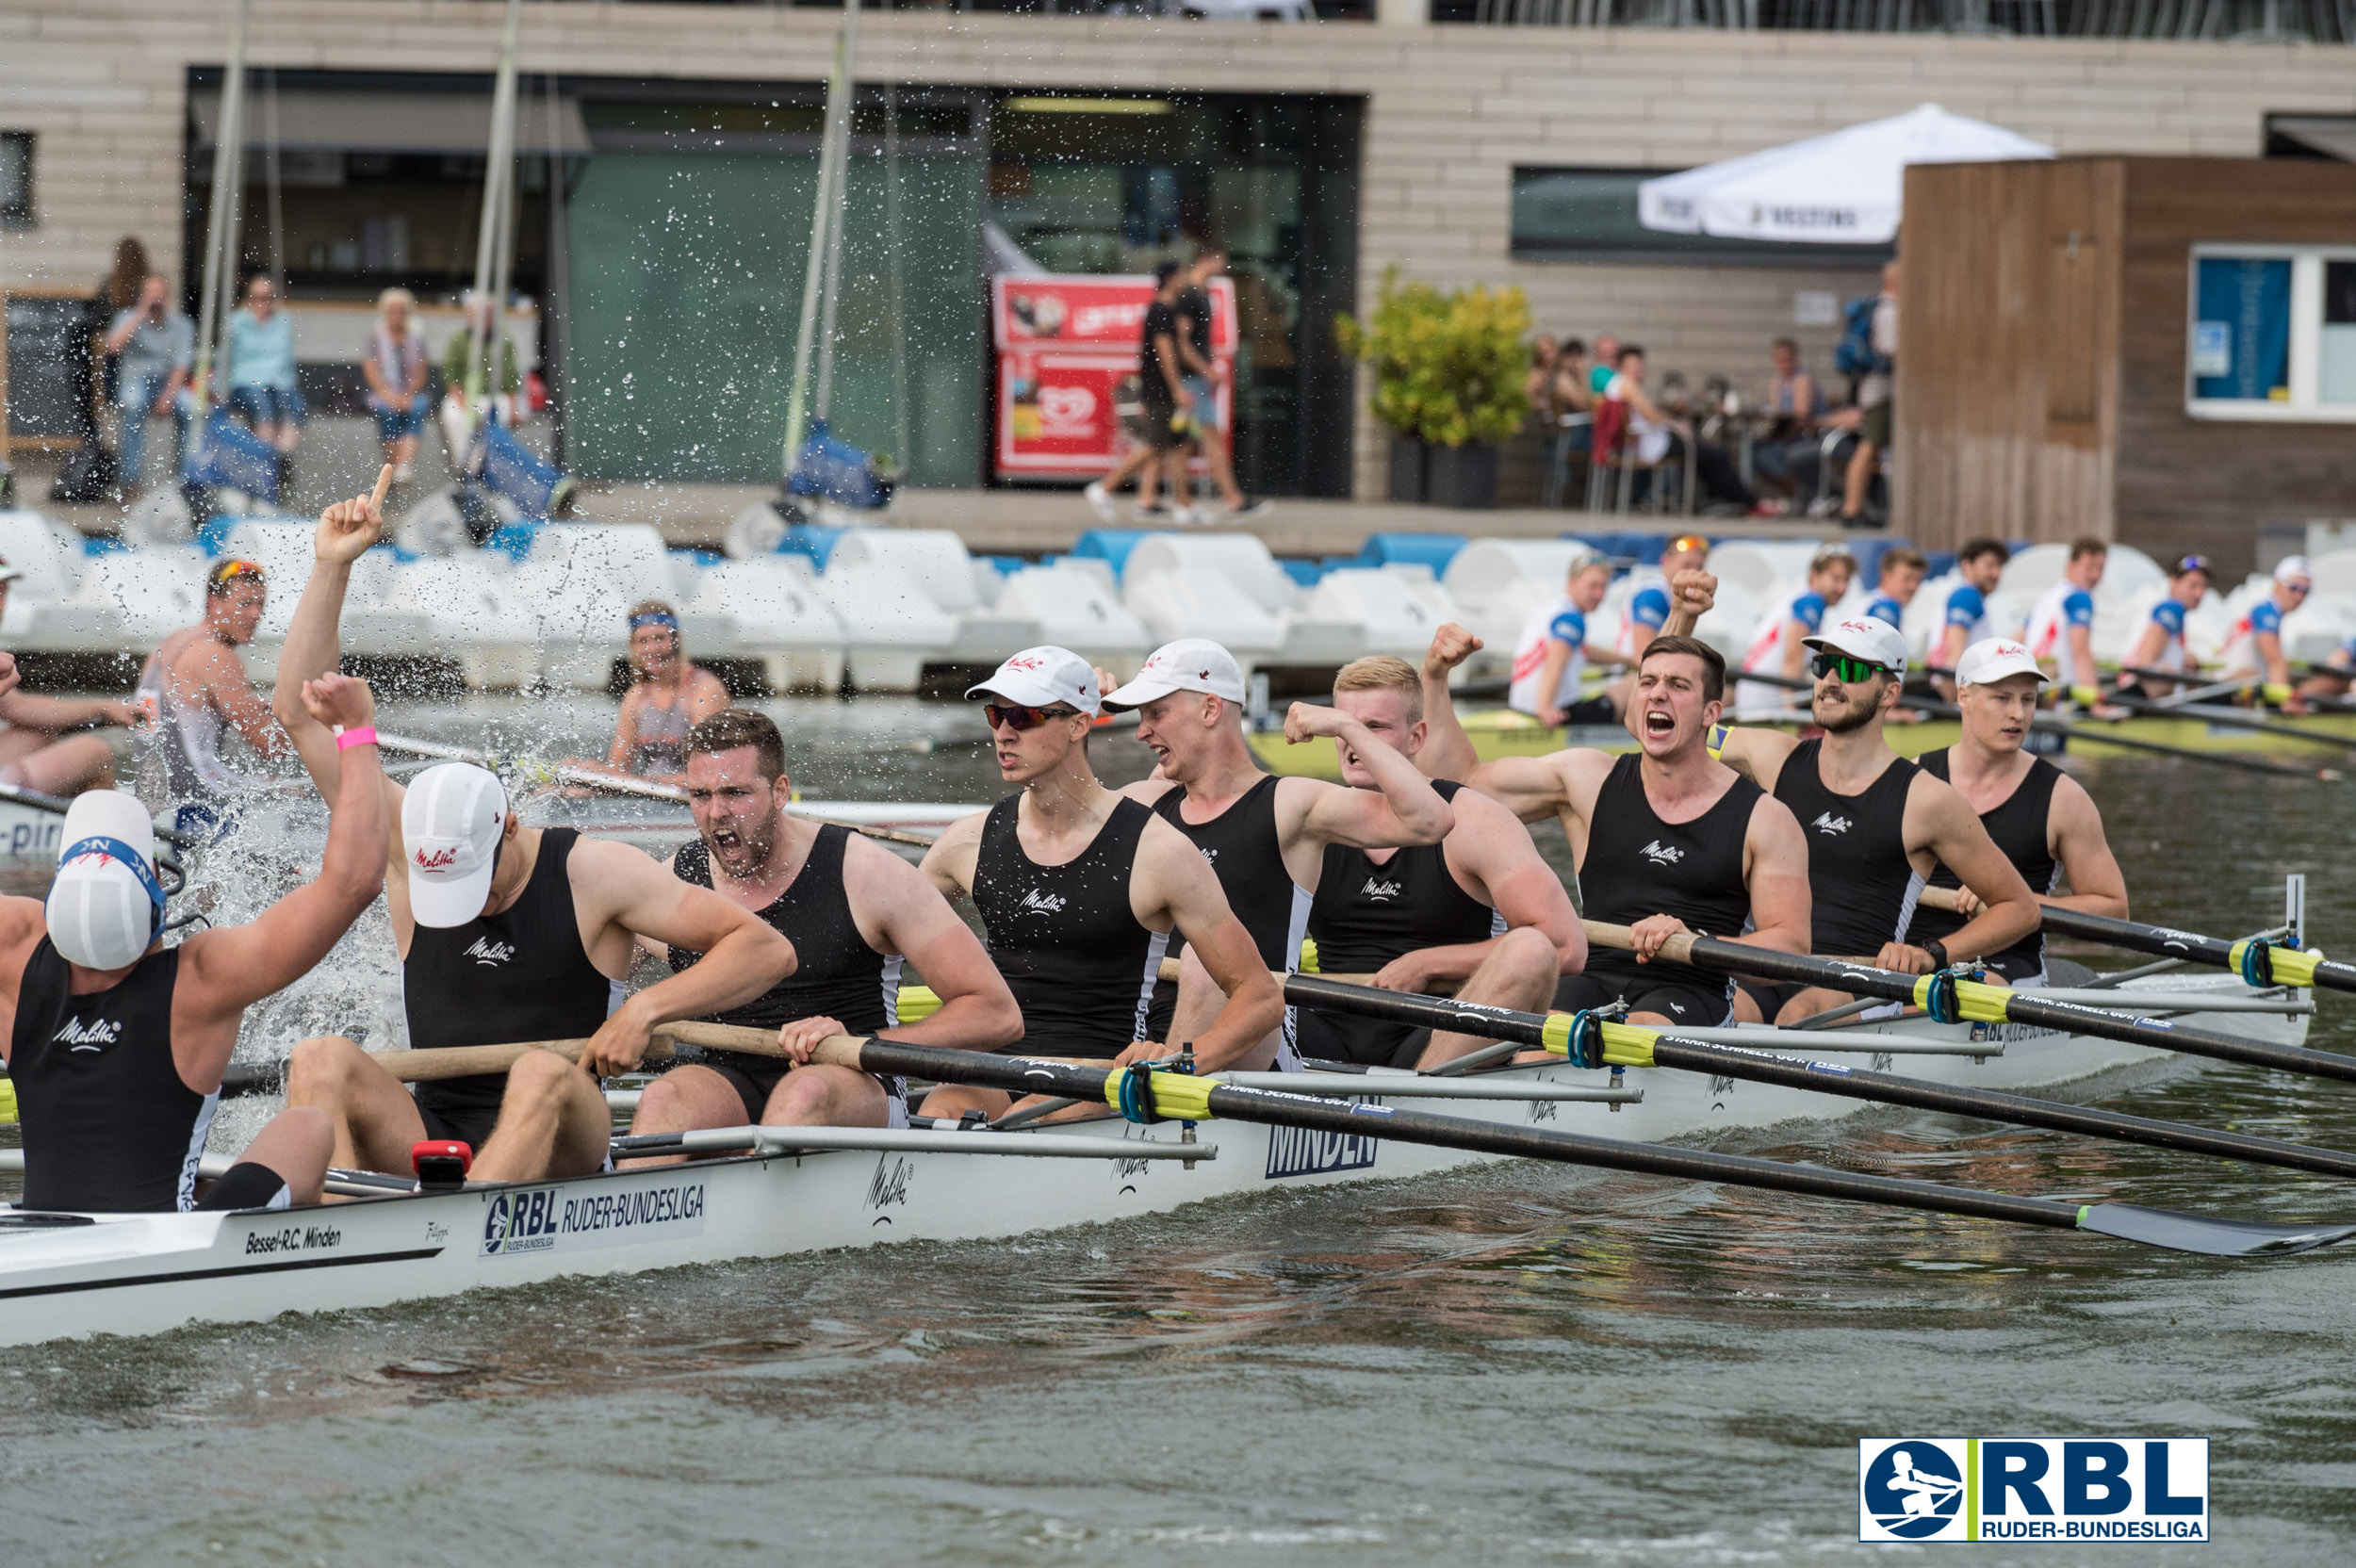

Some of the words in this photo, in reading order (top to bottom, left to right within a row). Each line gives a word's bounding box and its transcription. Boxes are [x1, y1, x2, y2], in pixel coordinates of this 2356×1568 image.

[509, 1189, 558, 1238] RBL
[562, 1184, 705, 1233] RUDER-BUNDESLIGA
[303, 1225, 341, 1249] Minden
